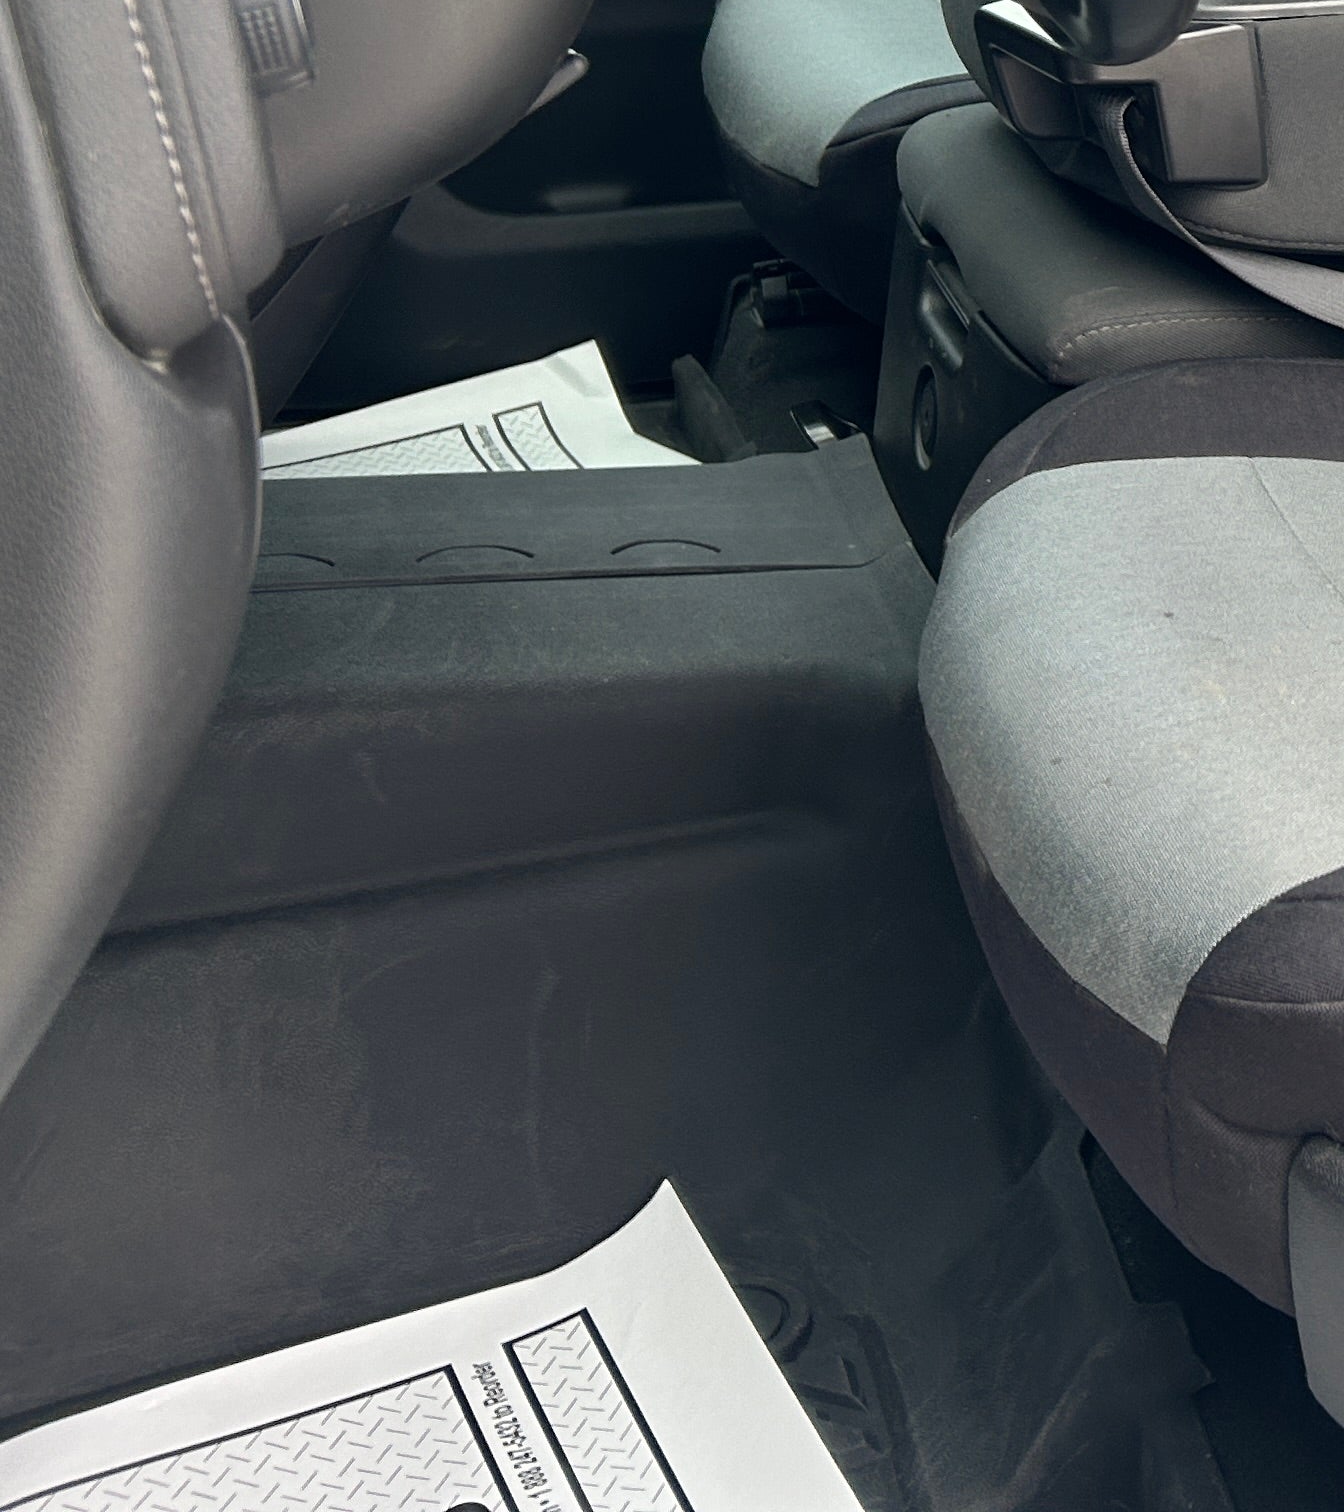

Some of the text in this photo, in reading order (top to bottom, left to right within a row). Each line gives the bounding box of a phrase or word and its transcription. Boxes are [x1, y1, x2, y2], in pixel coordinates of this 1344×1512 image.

[471, 1361, 508, 1408] Reorder
[492, 1404, 514, 1419] to
[517, 1466, 548, 1491] 888
